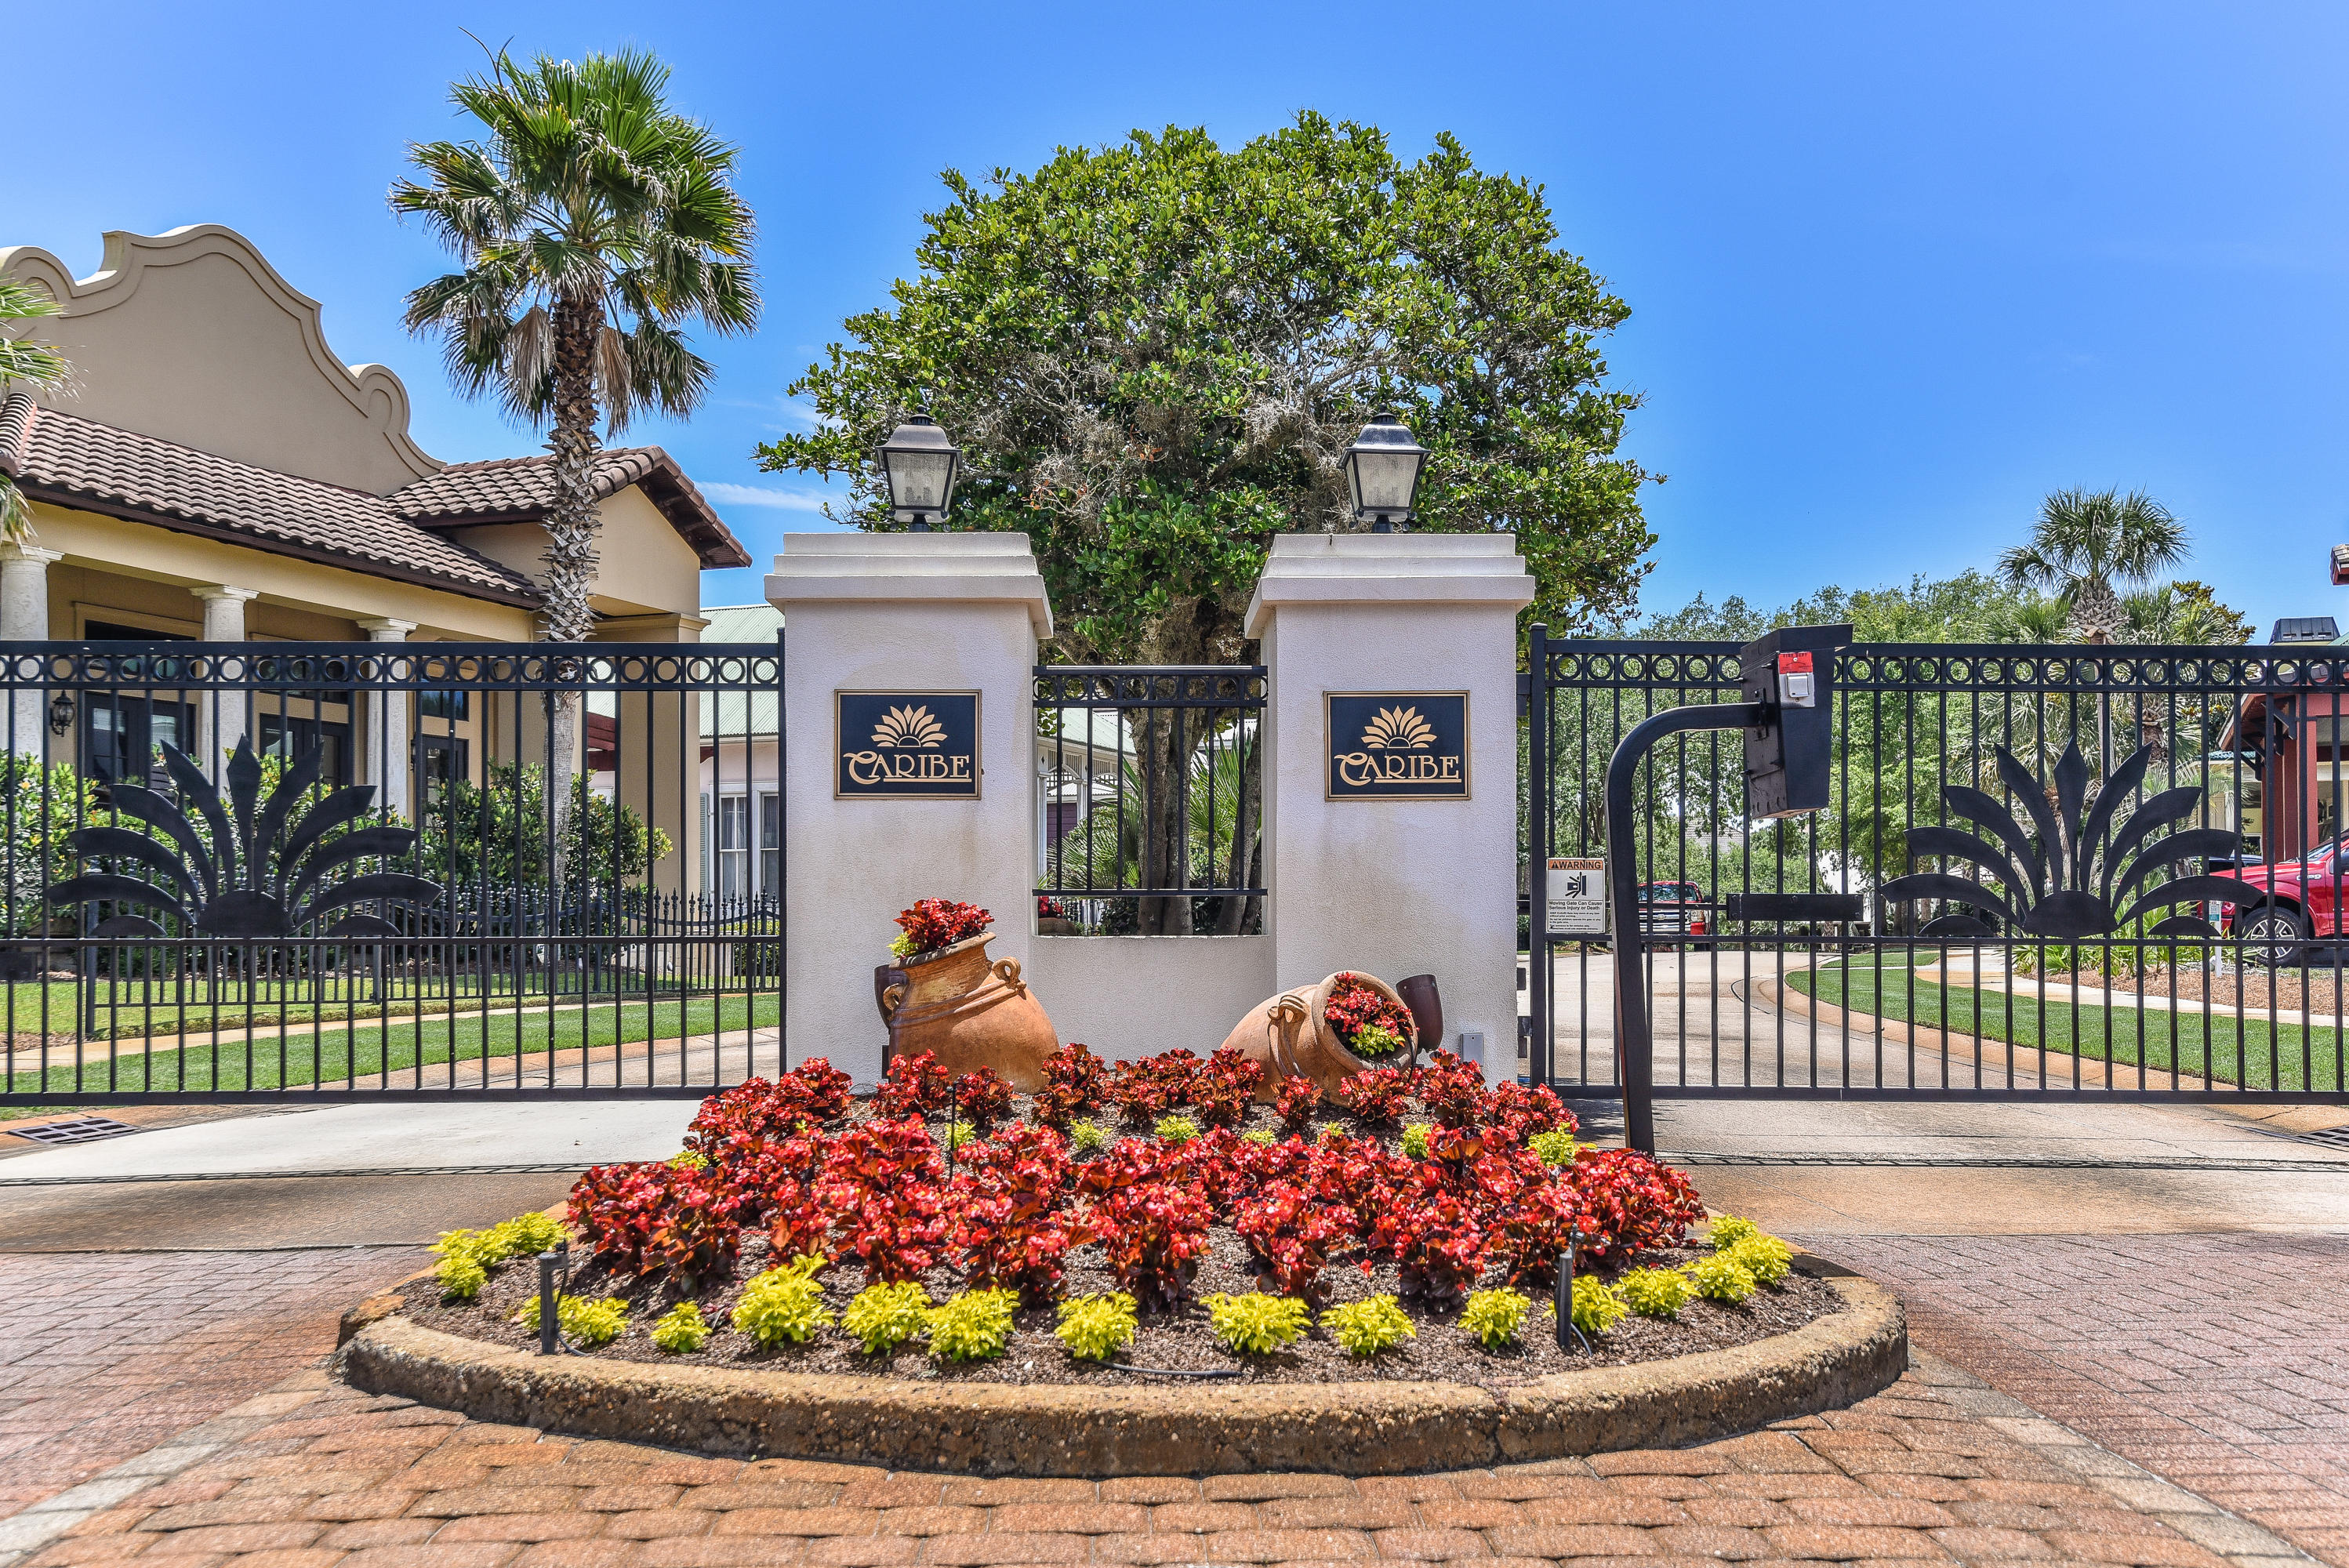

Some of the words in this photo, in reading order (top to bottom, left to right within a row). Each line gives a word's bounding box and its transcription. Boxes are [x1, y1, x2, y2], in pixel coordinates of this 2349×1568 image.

[843, 750, 970, 785] CARIBE
[1334, 752, 1459, 786] CARIBE
[1559, 861, 1601, 869] WARNING
